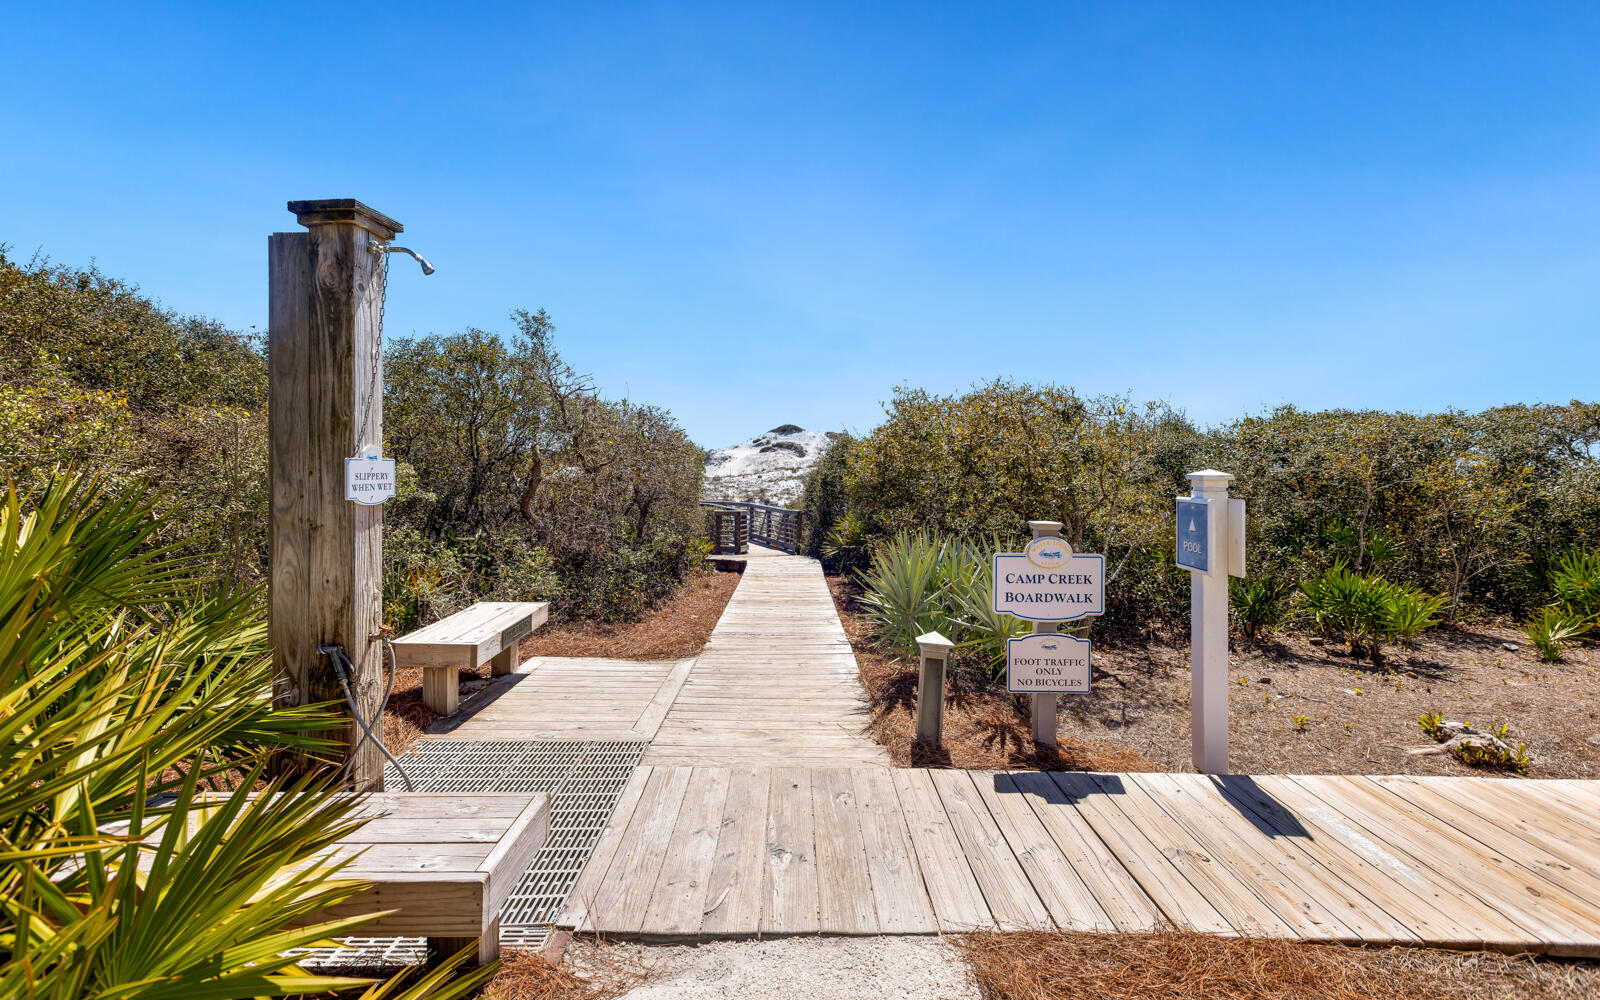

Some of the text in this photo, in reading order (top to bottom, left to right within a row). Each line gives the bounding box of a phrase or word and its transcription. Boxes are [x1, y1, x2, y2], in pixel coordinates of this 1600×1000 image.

[354, 472, 389, 480] SLIPPERY
[352, 482, 392, 491] WHEN WET
[1183, 540, 1202, 554] POOL
[1005, 573, 1093, 585] CAMP CREEK
[1004, 591, 1093, 604] BOARDWALK
[1014, 658, 1085, 667] FOOT TRAFFIC
[1035, 667, 1063, 676] ONLY
[1017, 678, 1082, 687] NO BICYCLES
